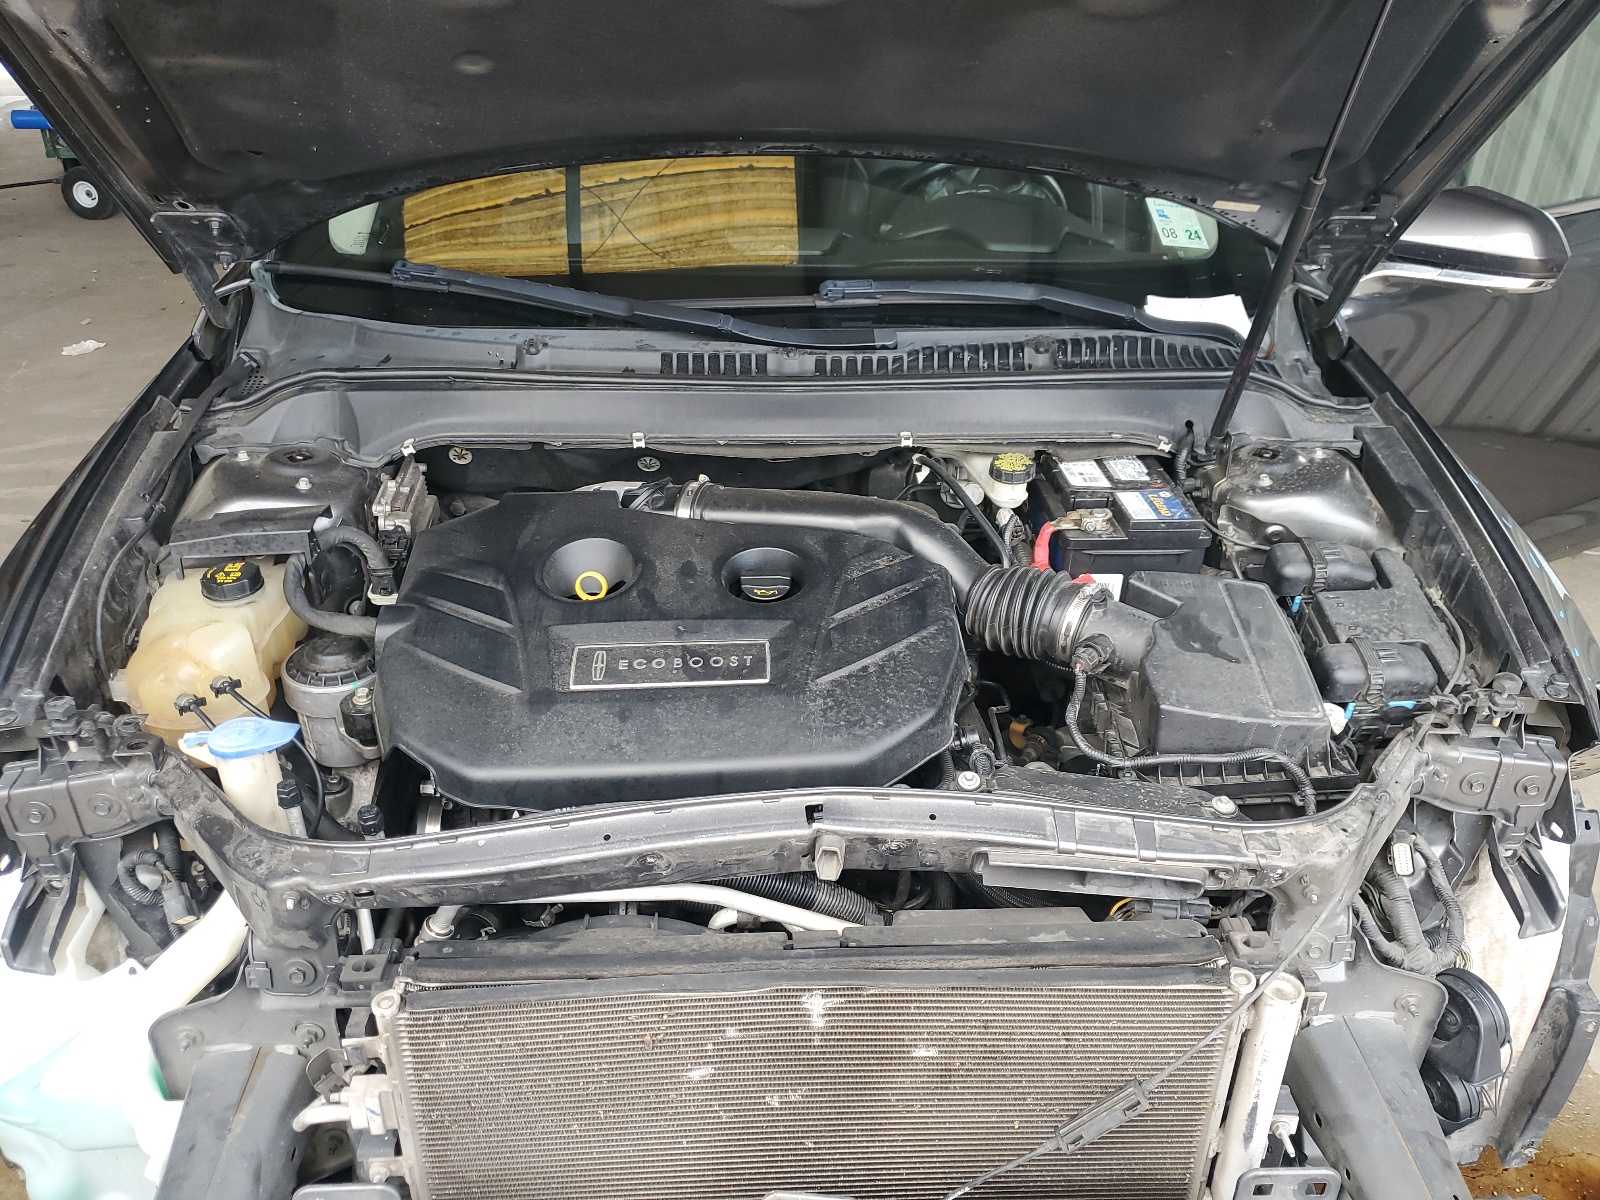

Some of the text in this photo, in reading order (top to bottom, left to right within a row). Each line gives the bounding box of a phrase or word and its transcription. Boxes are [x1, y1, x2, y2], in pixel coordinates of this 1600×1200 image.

[1161, 227, 1202, 241] 08 24
[618, 655, 753, 670] ECOBOOST
